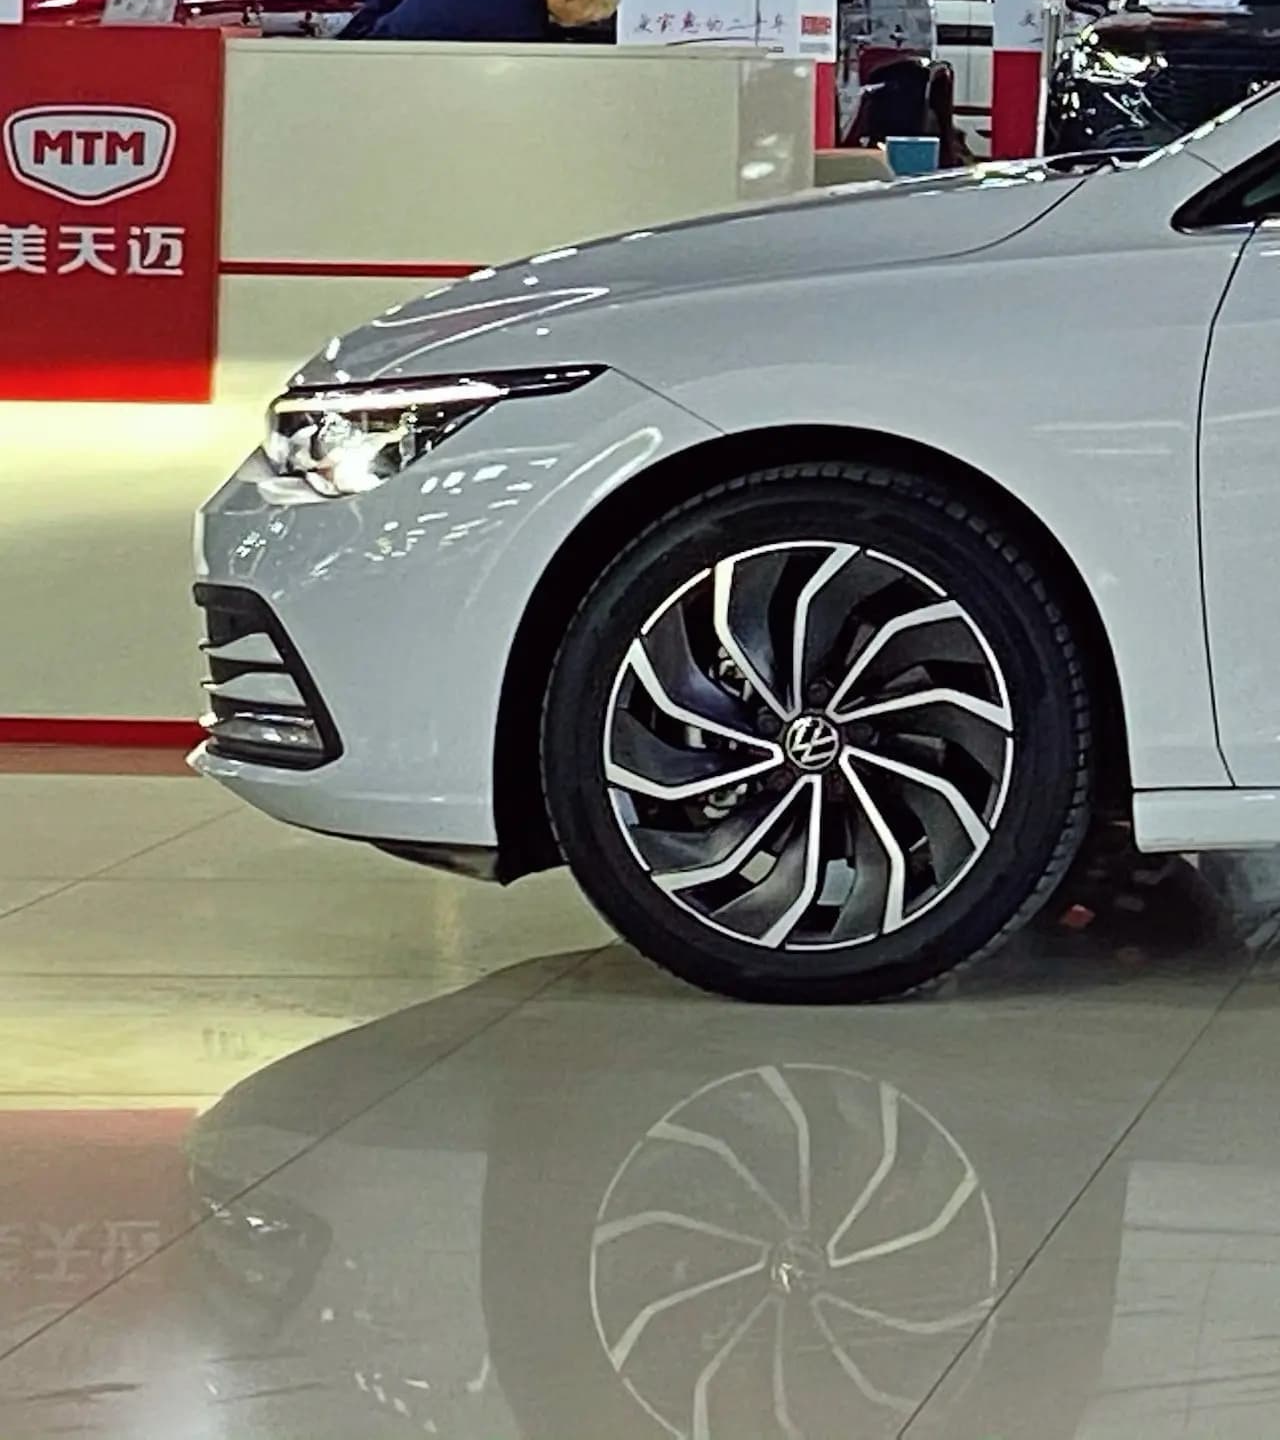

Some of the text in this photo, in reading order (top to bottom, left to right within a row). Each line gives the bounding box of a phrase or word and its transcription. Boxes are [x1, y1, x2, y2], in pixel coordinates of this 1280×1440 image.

[33, 129, 146, 166] MTM
[0, 223, 186, 277] 美天迈
